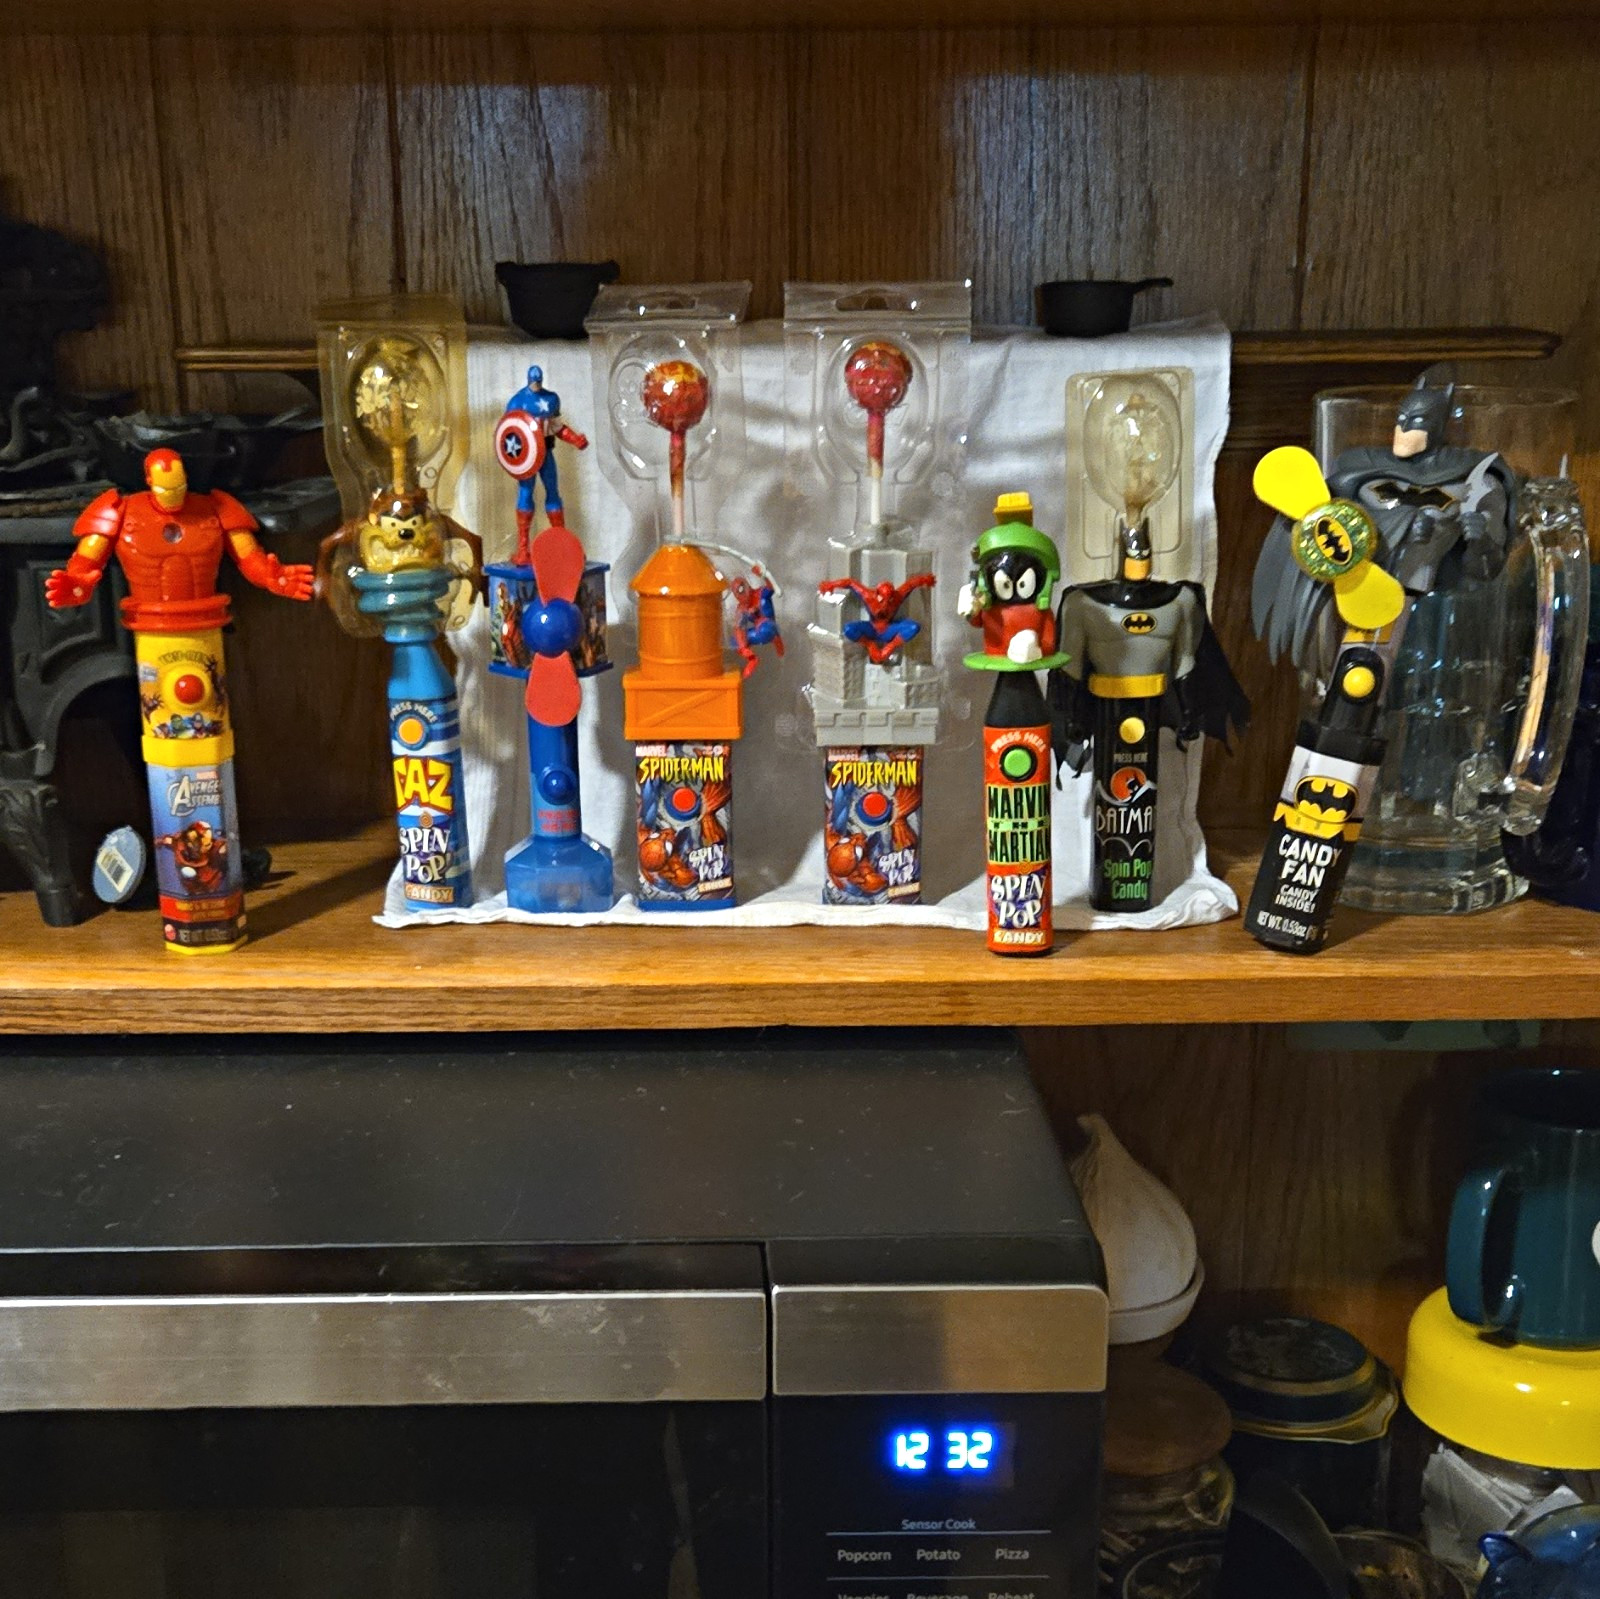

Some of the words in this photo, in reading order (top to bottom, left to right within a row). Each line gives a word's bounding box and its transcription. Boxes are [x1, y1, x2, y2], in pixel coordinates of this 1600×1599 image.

[990, 731, 1021, 753] PRESS
[393, 757, 452, 810] TAZ
[1096, 804, 1153, 834] BATMA
[399, 827, 450, 855] SPIN
[1278, 833, 1342, 868] CANDY
[1104, 858, 1130, 881] Spin
[1281, 858, 1326, 888] FAN
[991, 873, 1047, 901] SPIN
[1112, 880, 1148, 901] Candy
[1280, 884, 1320, 902] CANDY
[1275, 894, 1316, 914] INSIDE!
[993, 931, 1044, 945] CANDY
[946, 1431, 993, 1469] 32
[901, 1519, 943, 1530] Sensor
[945, 1518, 977, 1530] Cook
[837, 1549, 892, 1563] Popcorn
[916, 1549, 961, 1561] Potato
[994, 1548, 1030, 1560] Pizza
